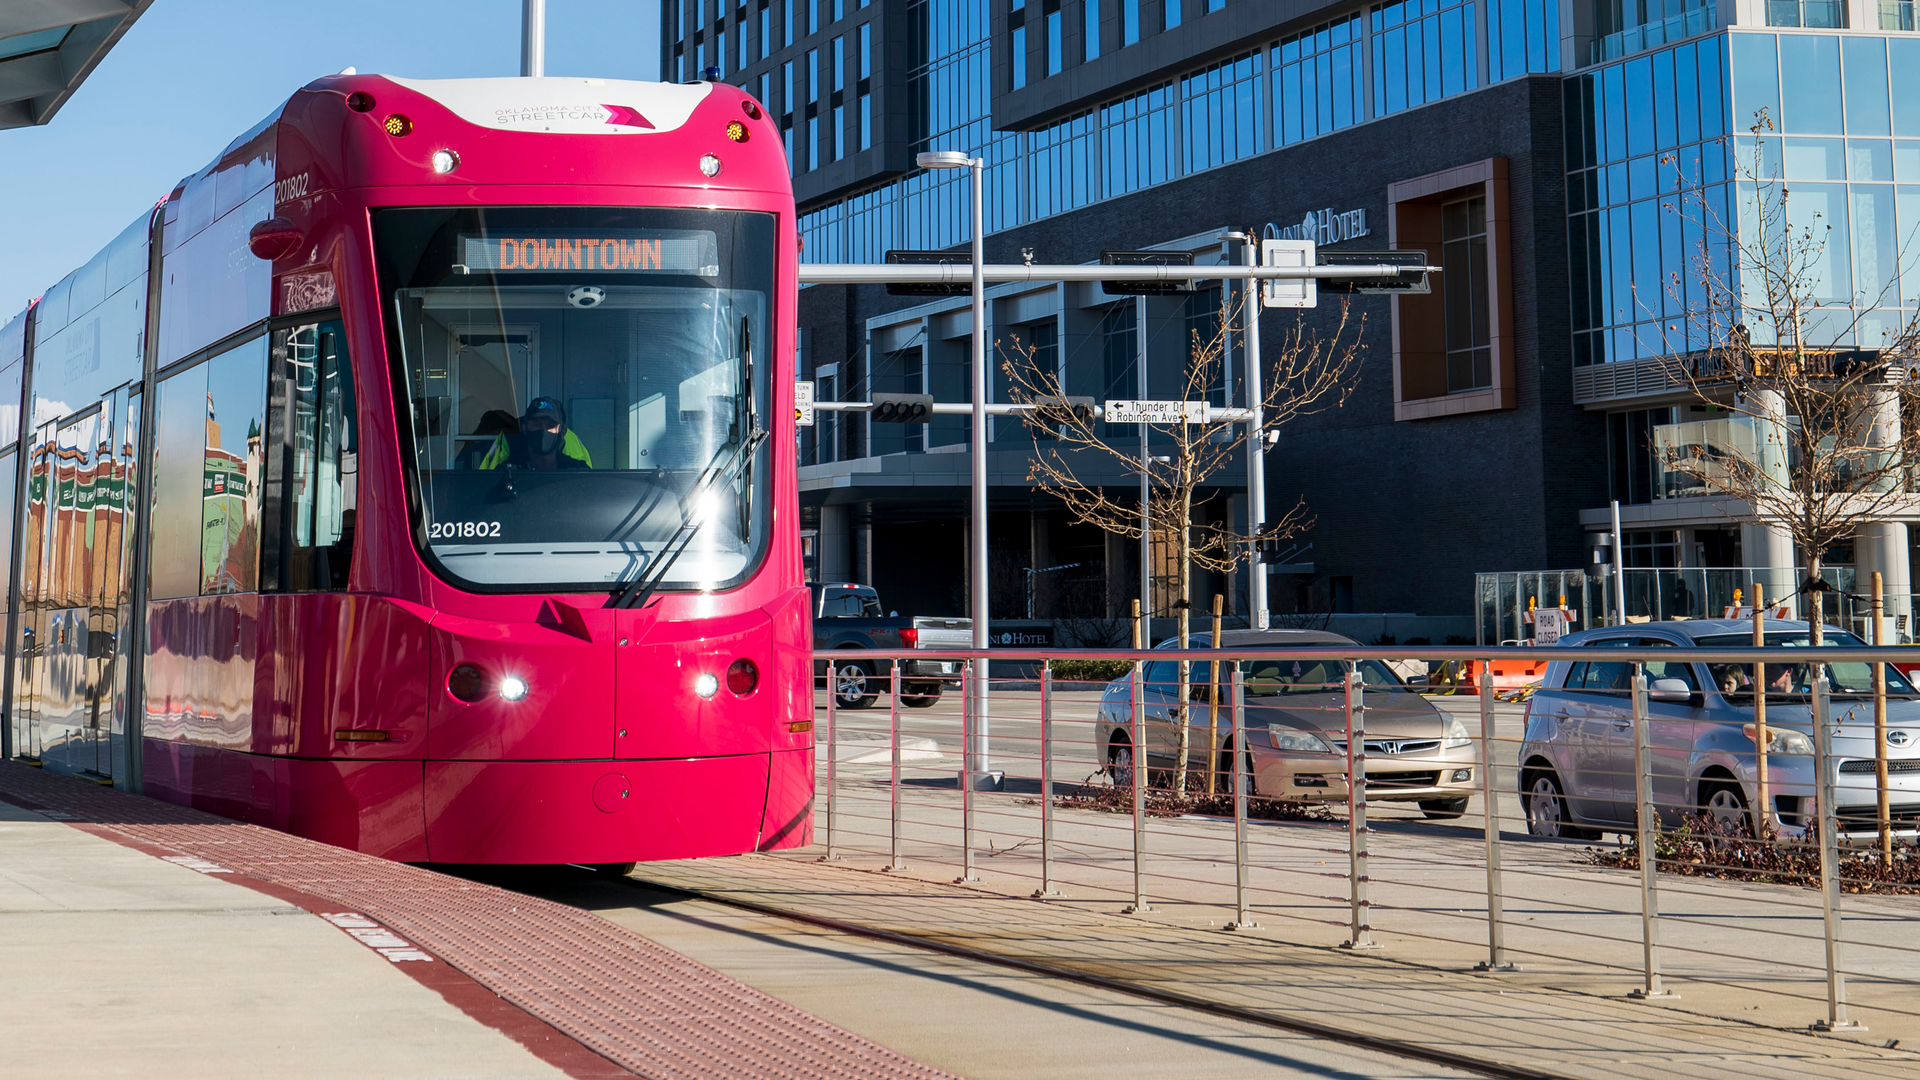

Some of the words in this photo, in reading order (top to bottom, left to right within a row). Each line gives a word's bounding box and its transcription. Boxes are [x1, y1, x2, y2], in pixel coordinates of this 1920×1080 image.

[494, 105, 569, 116] OKLAHOMA
[497, 111, 605, 124] STREETCAR
[275, 172, 309, 205] 201802
[1317, 207, 1368, 246] HOTEL
[500, 238, 661, 270] DOWNTOWN
[1131, 401, 1168, 412] Thunder
[1173, 402, 1184, 412] Dr
[1106, 412, 1112, 422] S
[1117, 412, 1158, 422] Robinson
[1161, 413, 1179, 422] Ave
[430, 521, 501, 539] 201802
[1540, 615, 1555, 628] ROAD
[1012, 632, 1049, 645] HOTEL
[1537, 631, 1558, 644] CLOSED
